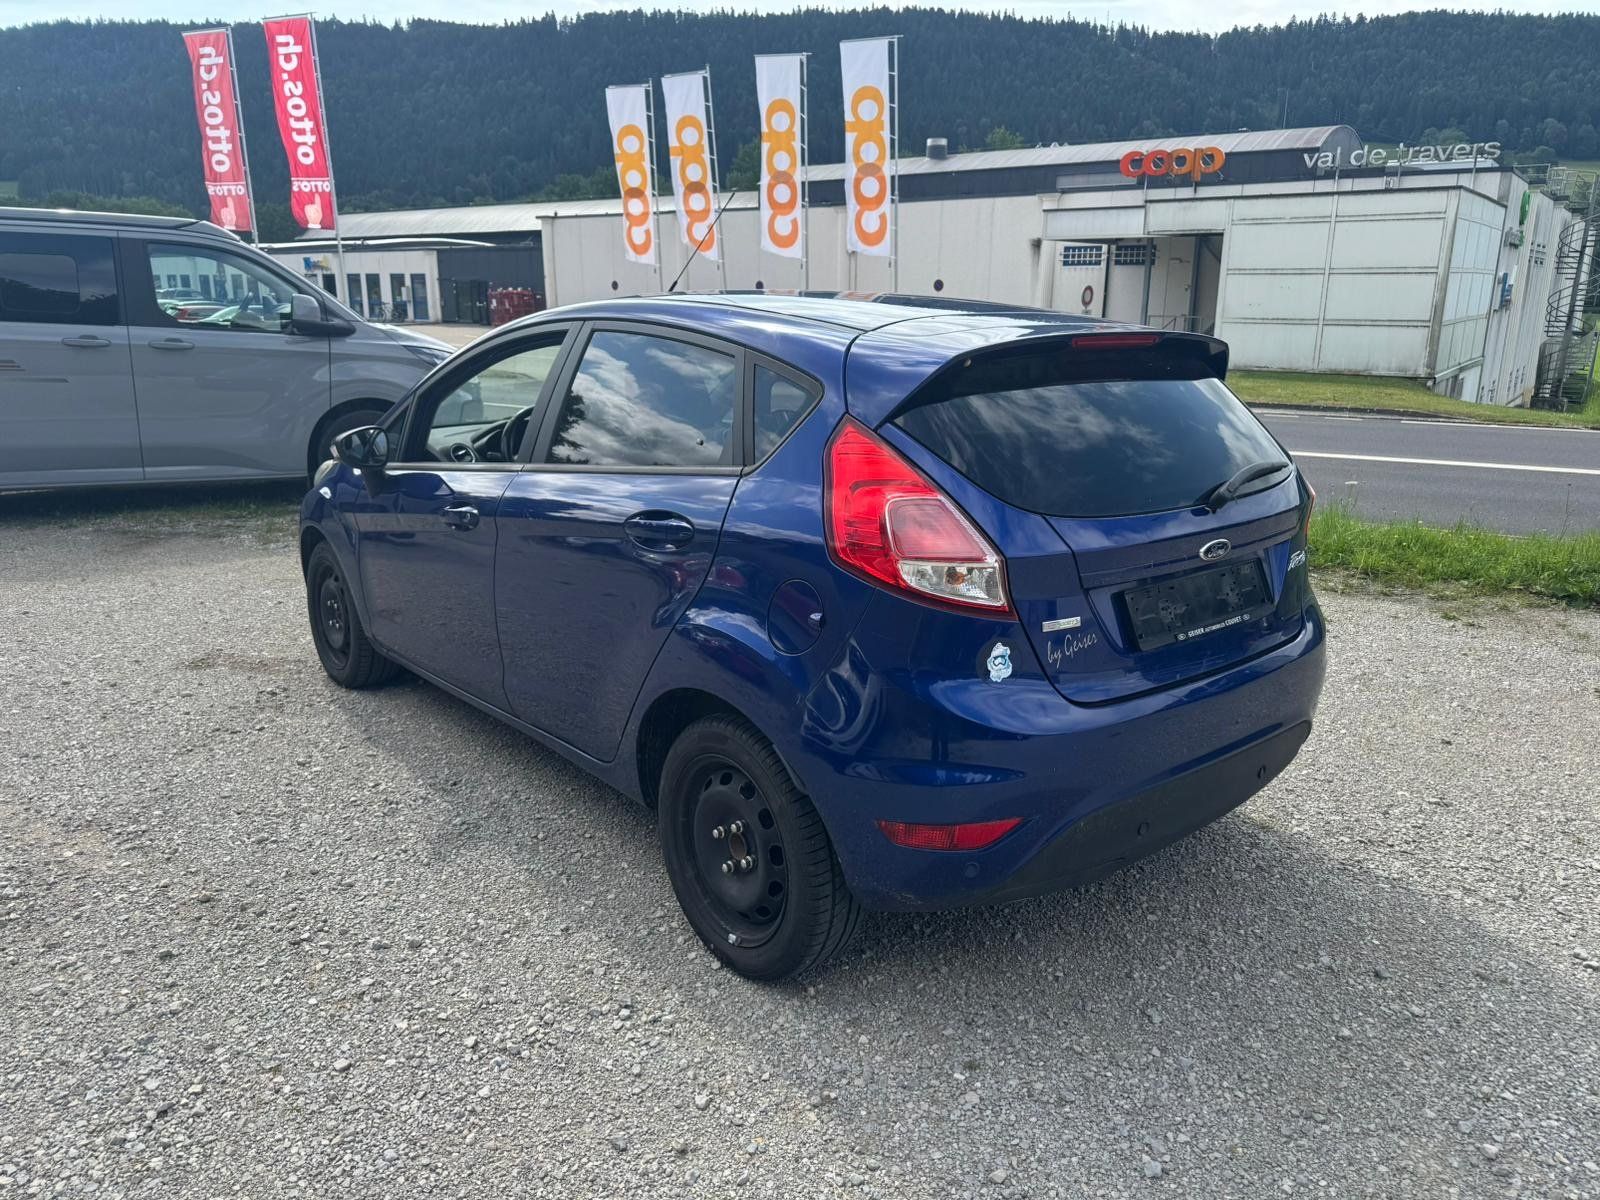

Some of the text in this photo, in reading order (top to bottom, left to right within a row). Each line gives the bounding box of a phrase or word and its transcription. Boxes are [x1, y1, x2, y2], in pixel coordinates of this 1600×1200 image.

[1119, 146, 1226, 182] coop
[1303, 141, 1501, 169] val de travers
[1187, 627, 1205, 637] GEISER
[1225, 615, 1242, 626] COUVET
[1047, 633, 1098, 669] by Geiser
